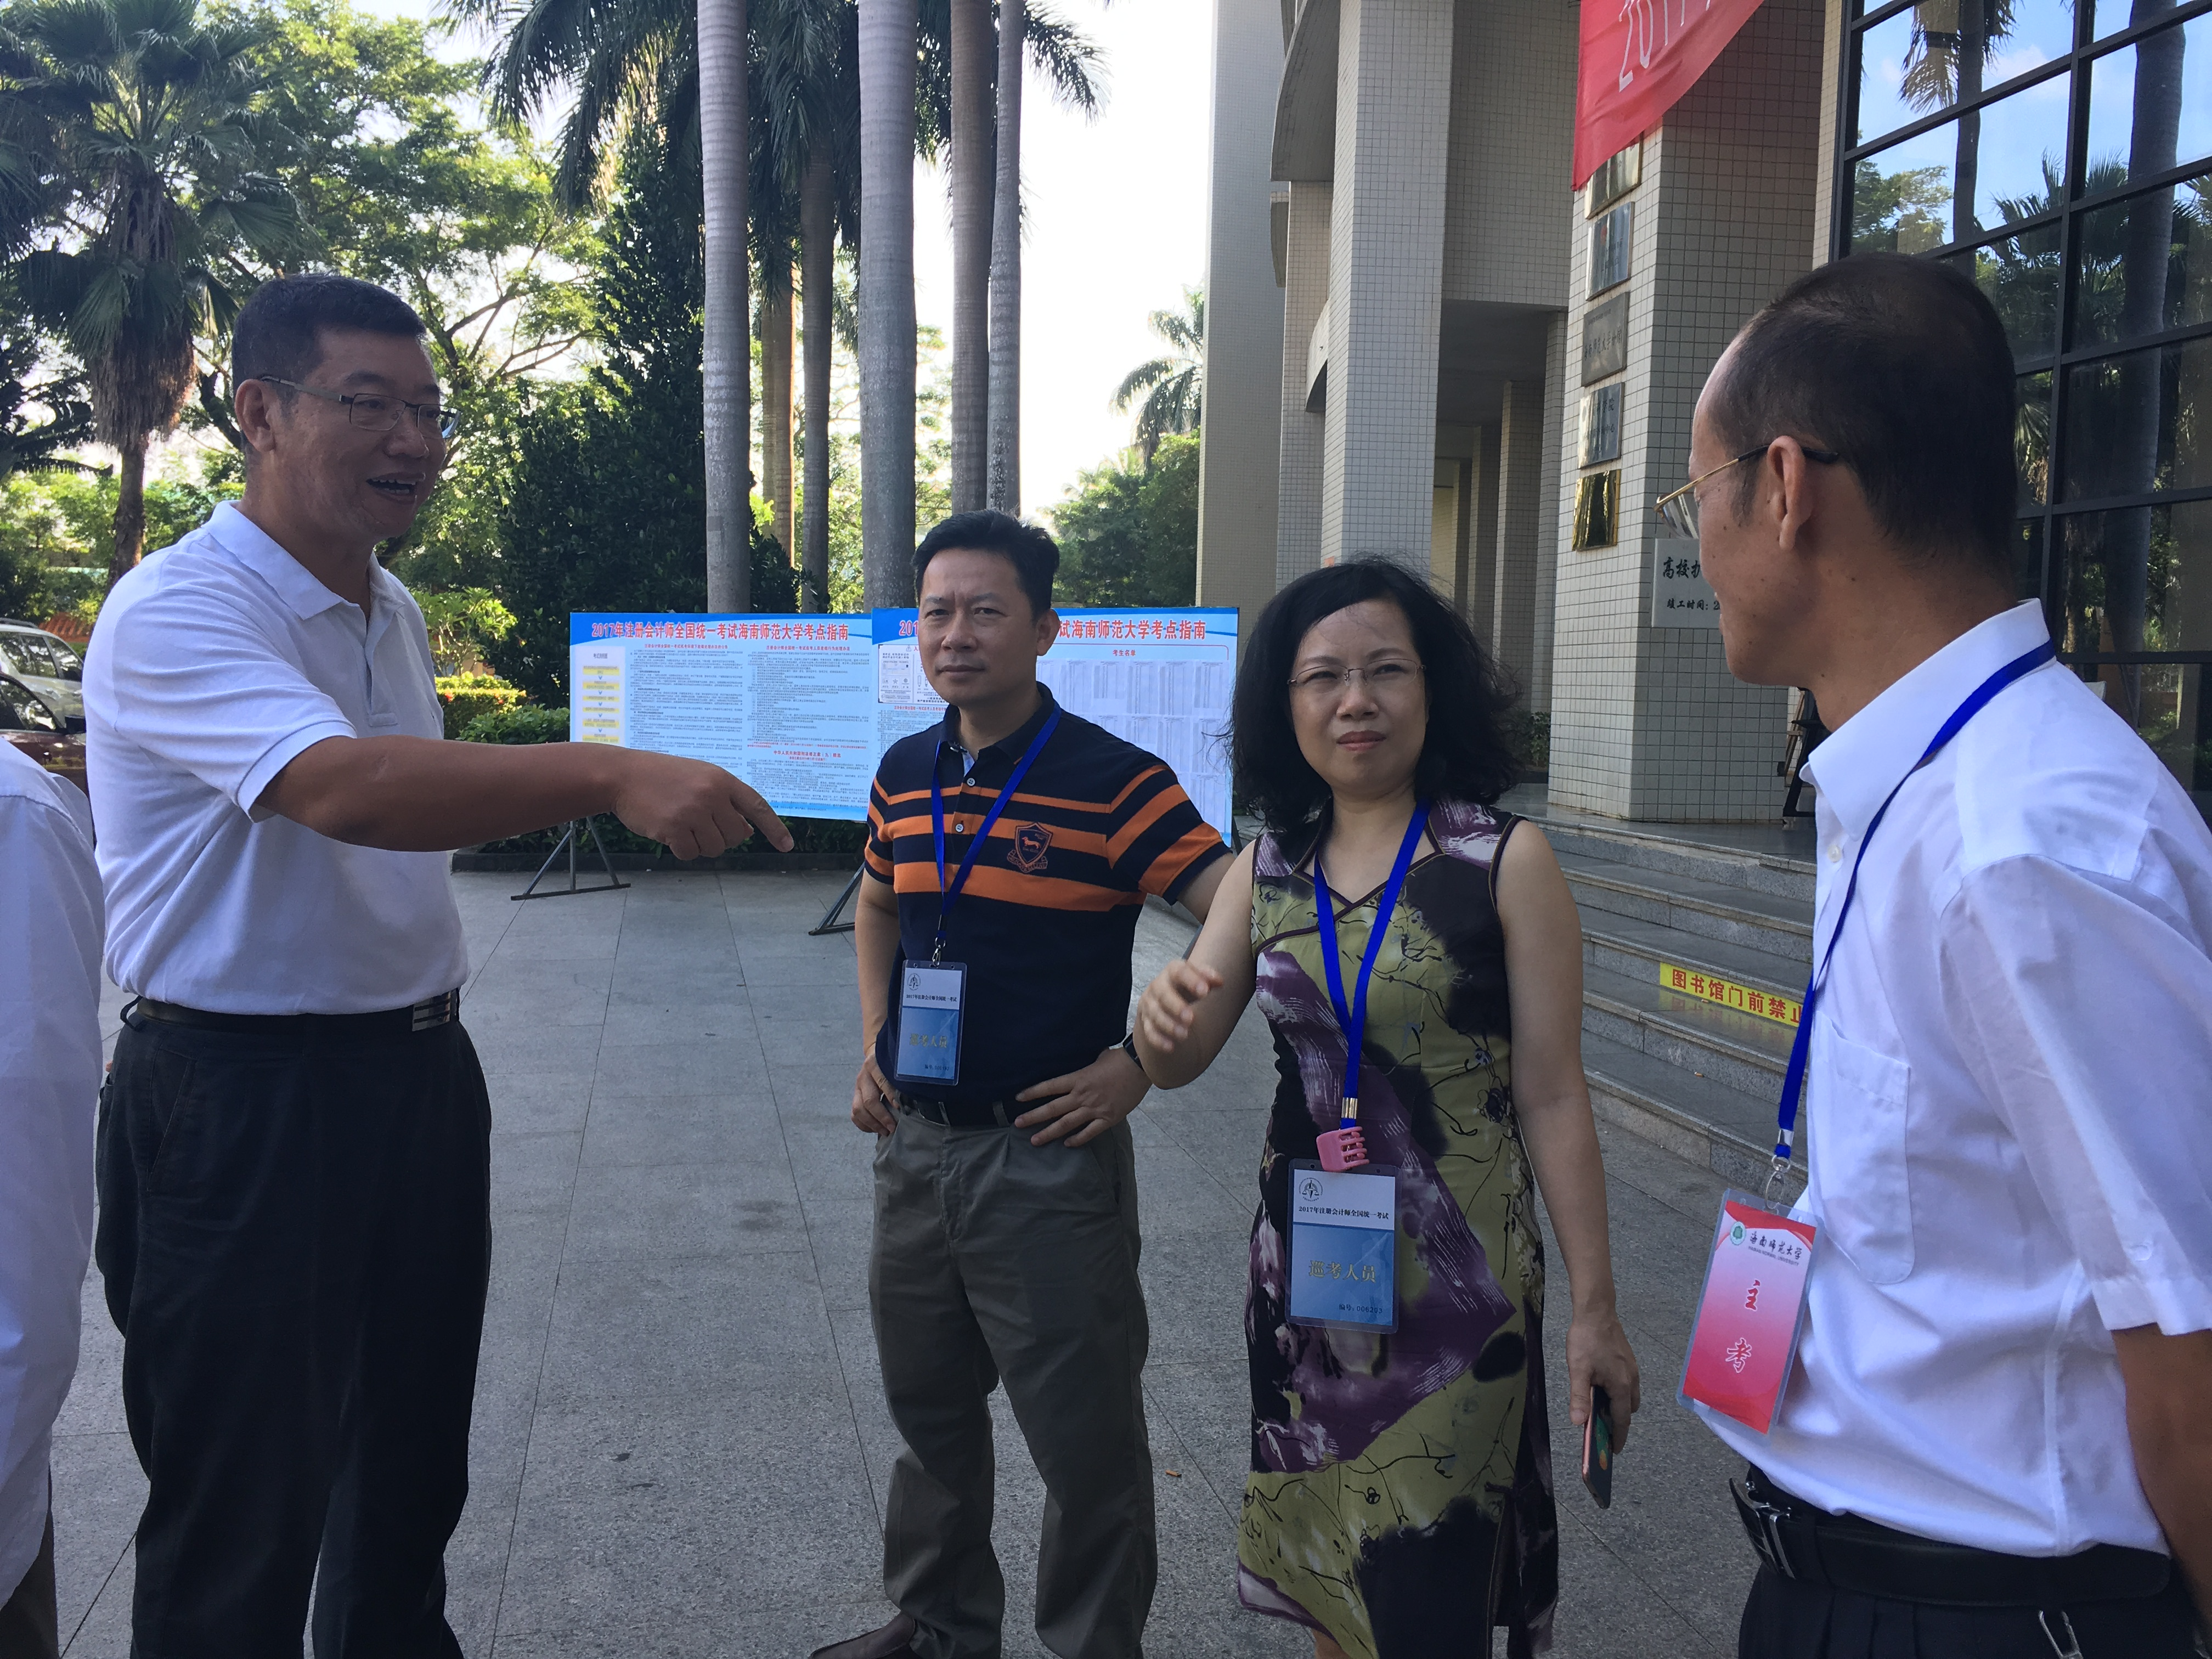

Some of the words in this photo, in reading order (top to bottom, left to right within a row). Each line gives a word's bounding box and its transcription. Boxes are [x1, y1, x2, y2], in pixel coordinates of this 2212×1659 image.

[592, 622, 849, 640] 2017年注册会计师全国统一考试海南师范大学考点指南
[1059, 620, 1206, 640] 试海南师范大学考点指南
[1673, 969, 1803, 1024] 图书馆门前禁止
[1299, 1206, 1389, 1220] 2017年注册会计师全国统一考试
[1750, 1231, 1802, 1260] 海南师范大学
[1308, 1260, 1376, 1283] 巡考人员
